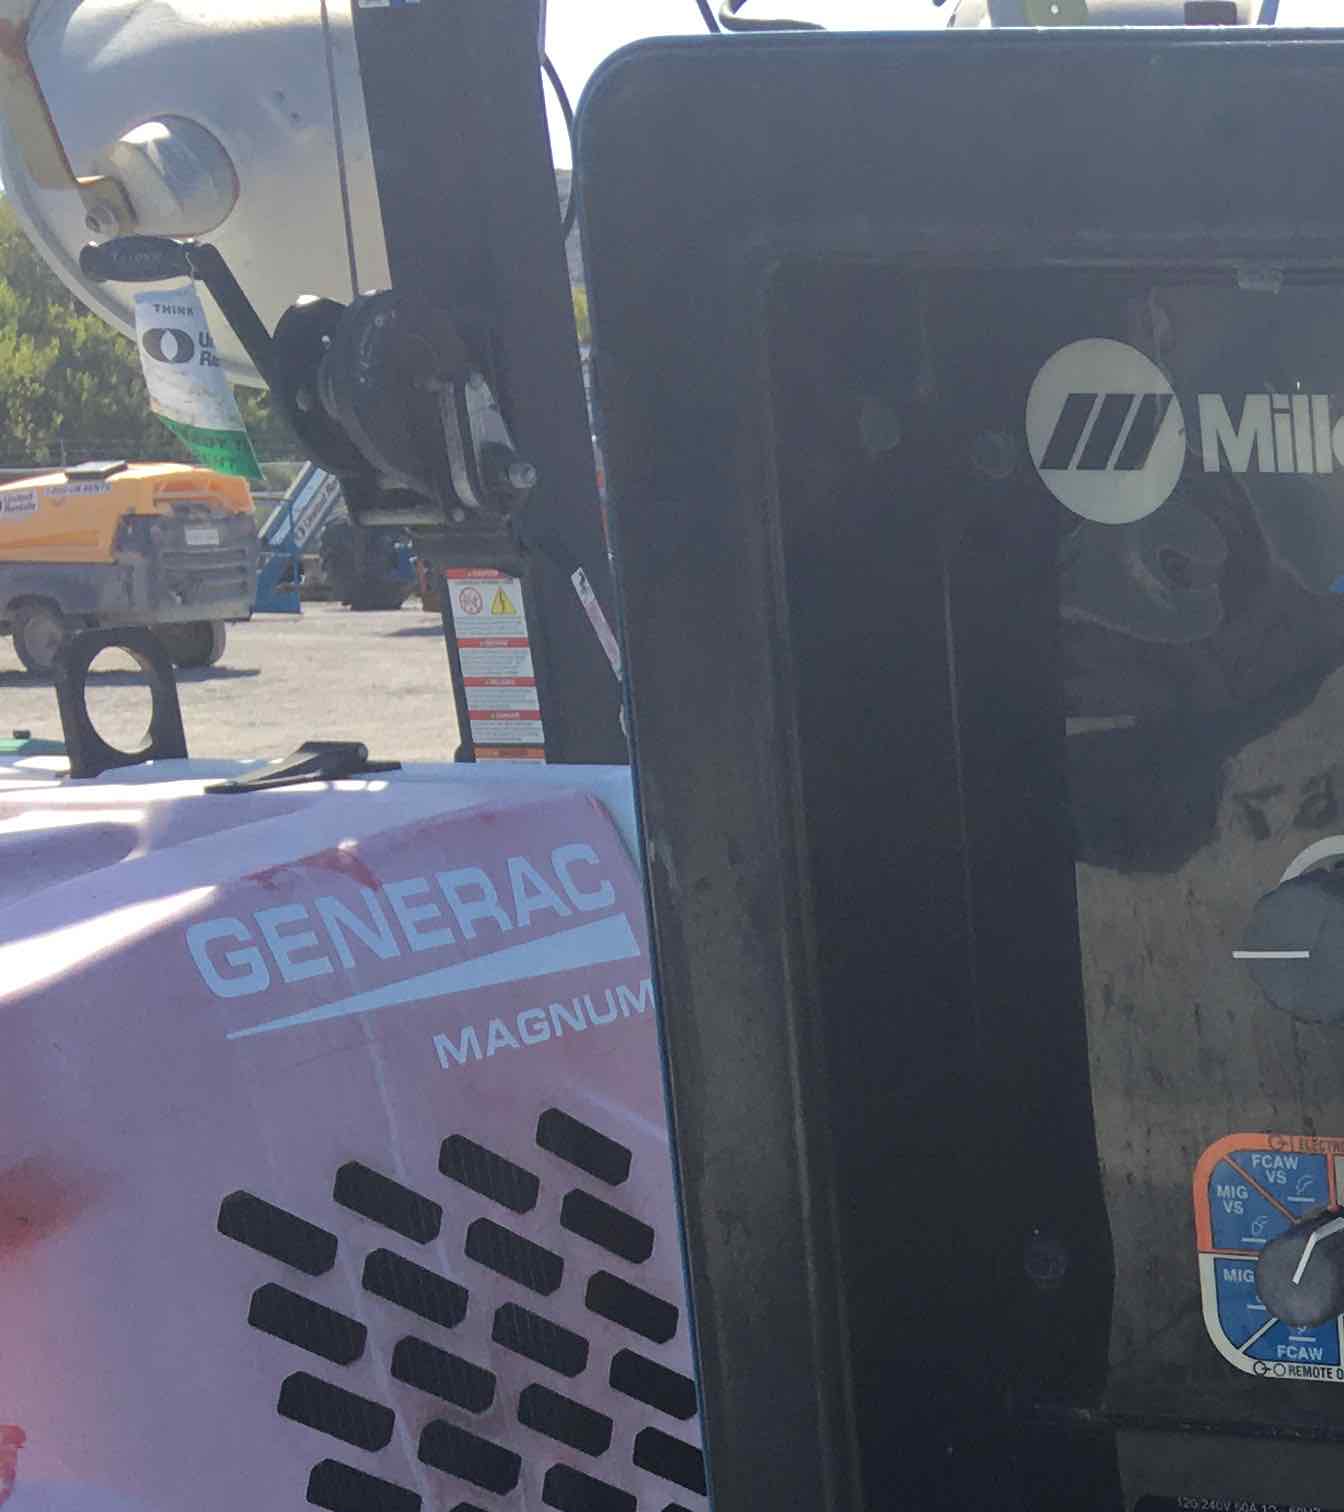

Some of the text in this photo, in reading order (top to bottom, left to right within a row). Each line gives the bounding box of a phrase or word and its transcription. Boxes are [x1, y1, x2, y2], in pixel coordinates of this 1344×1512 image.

[153, 303, 194, 316] THINK
[185, 843, 617, 1000] GENERAC
[432, 979, 656, 1070] MAGNUM
[1252, 1154, 1298, 1170] FCAW
[1265, 1170, 1287, 1184] VS
[1216, 1185, 1248, 1199] MIG
[1223, 1201, 1244, 1215] VS
[1223, 1268, 1255, 1283] MIG
[1276, 1345, 1323, 1361] FCAW
[1288, 1365, 1332, 1380] REMOTE
